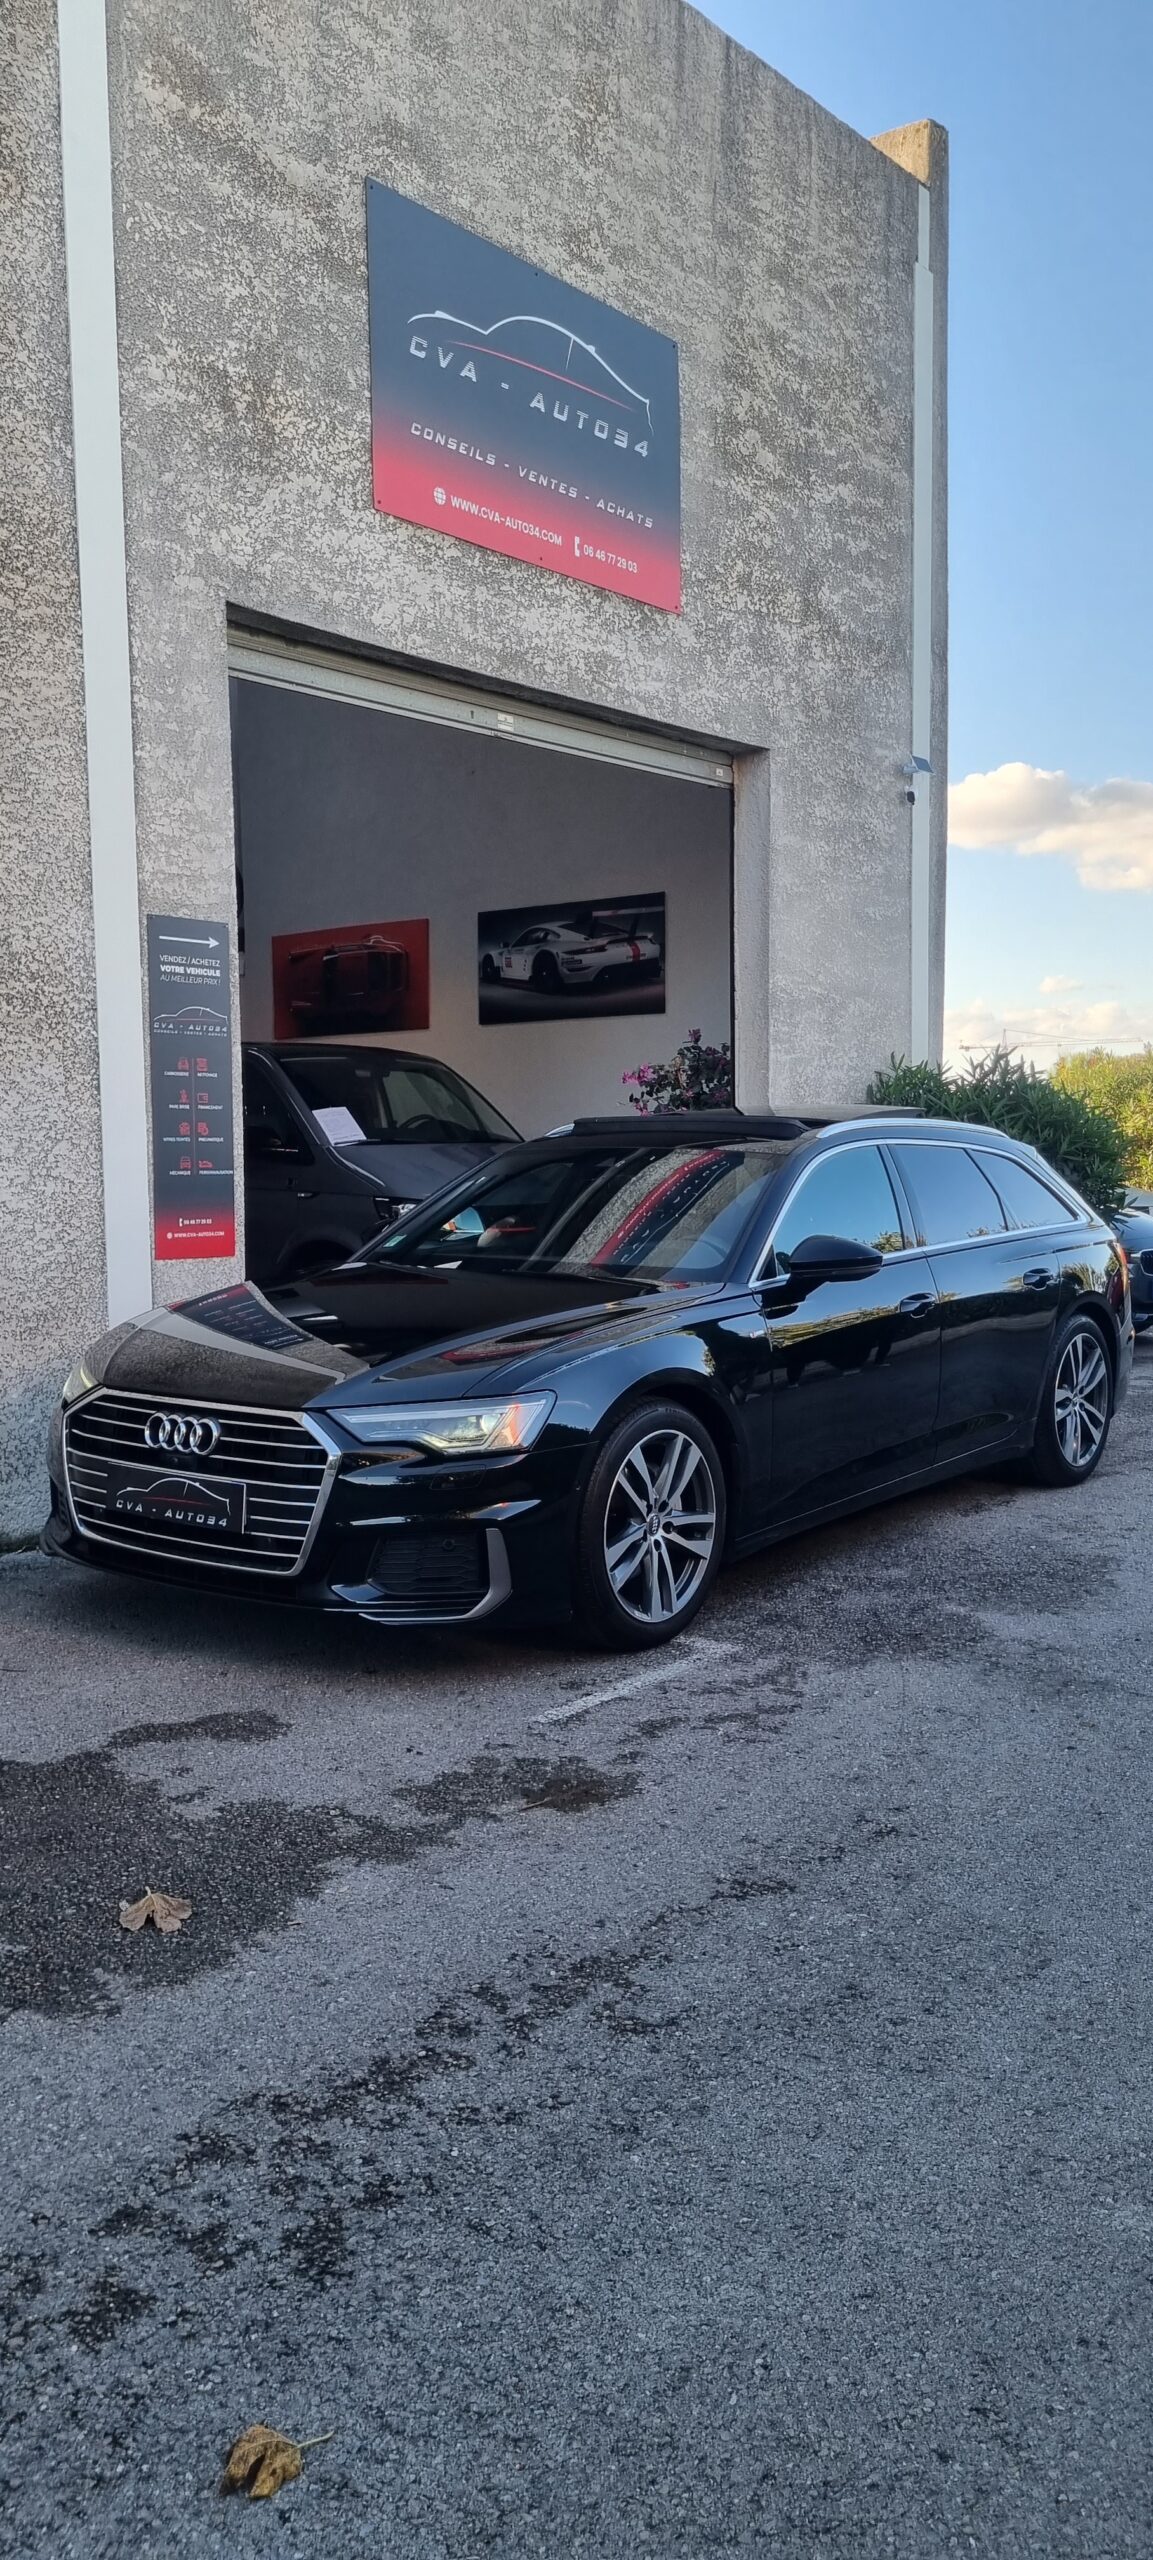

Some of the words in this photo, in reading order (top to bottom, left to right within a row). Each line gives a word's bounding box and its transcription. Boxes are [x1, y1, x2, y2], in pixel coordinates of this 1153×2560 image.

[409, 335, 477, 382] CVA
[530, 392, 649, 457] AUTO34
[410, 422, 496, 466] CONSEILS
[518, 465, 578, 498] VENTES
[597, 498, 653, 529] ACHATS
[450, 495, 562, 546] WWW.CVA-AUTO34.COM
[583, 544, 594, 557] 06
[595, 549, 606, 562] 46
[607, 552, 616, 566] 77
[617, 556, 627, 569] 29
[627, 560, 638, 573] 03
[159, 954, 187, 964] VENDEZ
[191, 957, 220, 967] ACHETEZ
[160, 964, 185, 974] VOTRE
[186, 966, 221, 977] VEHICULE
[160, 974, 170, 982] AU
[171, 975, 203, 984] MEILLEUR
[115, 1499, 143, 1512] CVA
[164, 1508, 228, 1527] AUTO34
